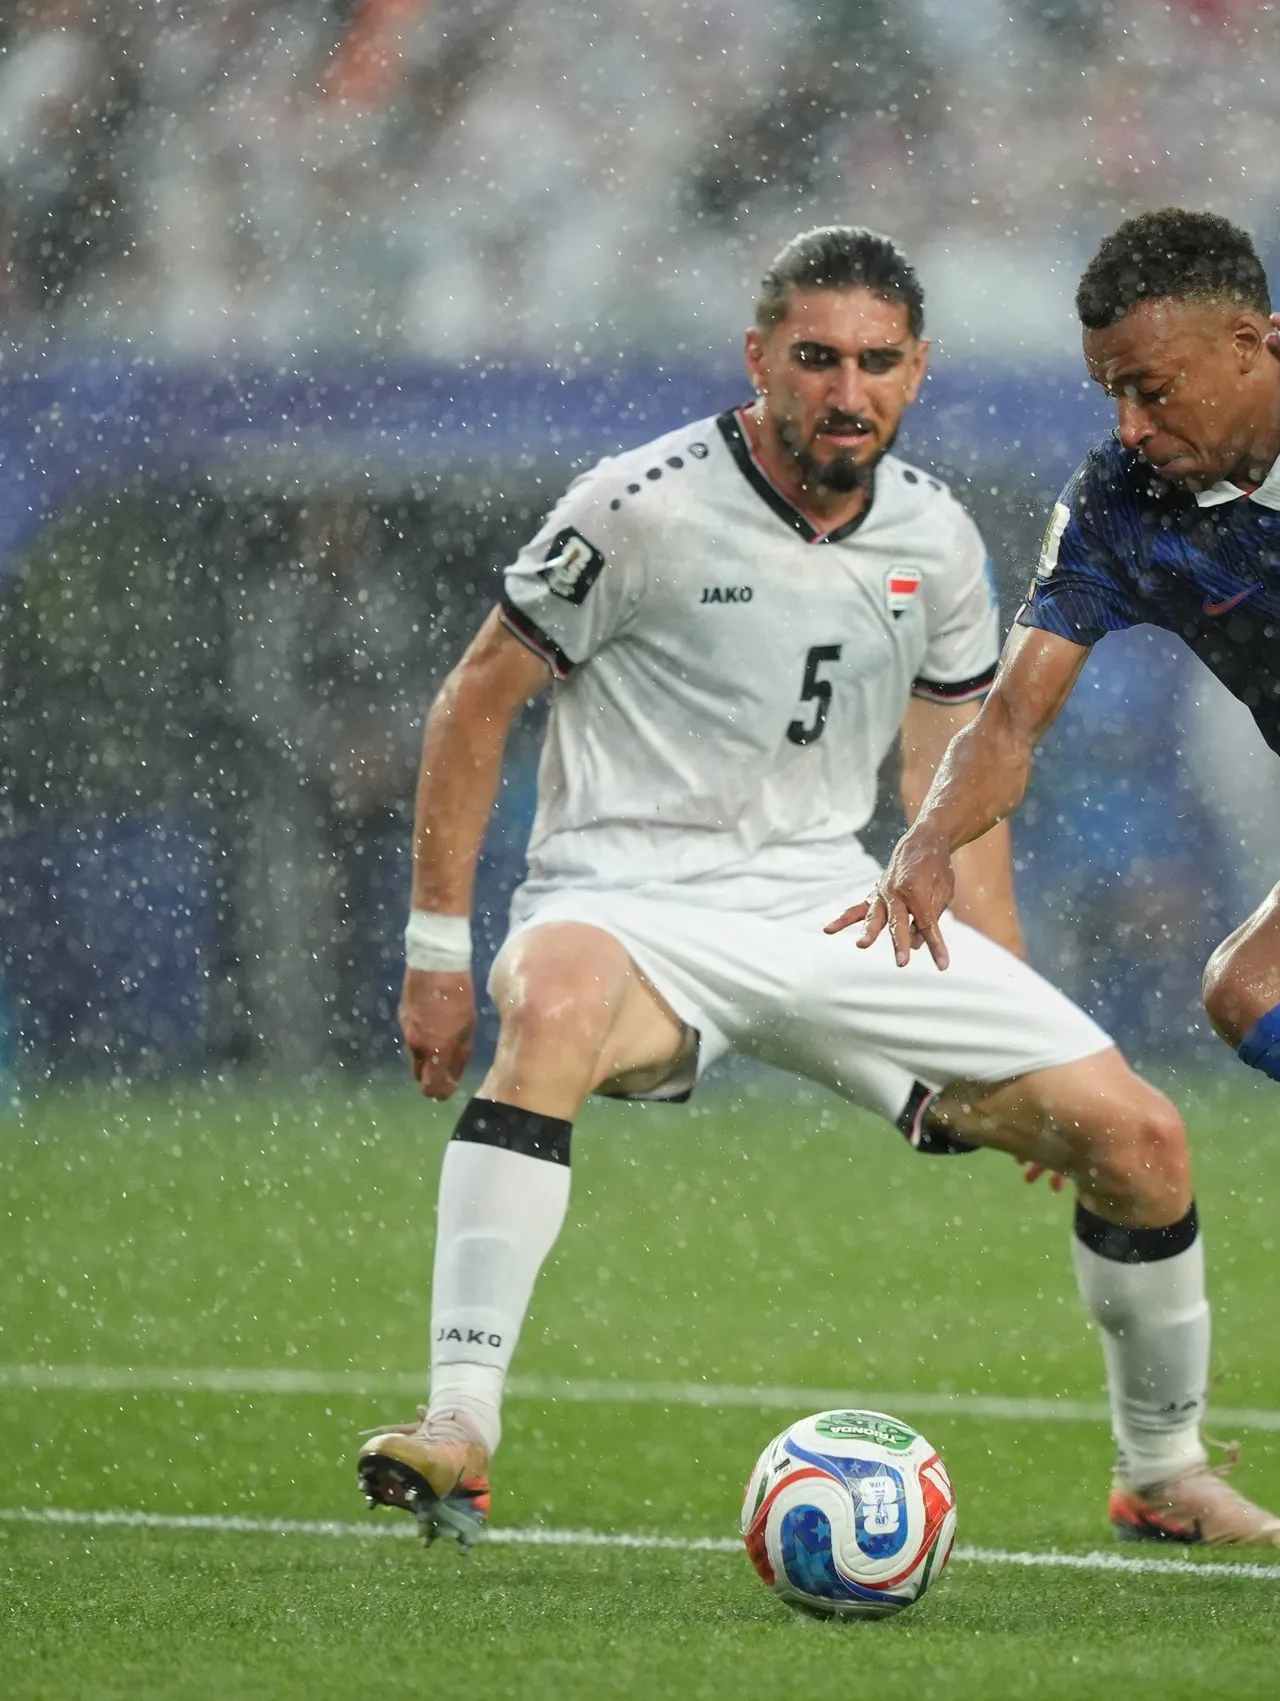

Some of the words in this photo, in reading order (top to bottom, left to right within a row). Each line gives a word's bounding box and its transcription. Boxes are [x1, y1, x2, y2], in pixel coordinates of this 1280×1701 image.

[700, 586, 754, 605] JAKO
[786, 644, 842, 746] 5
[436, 1327, 502, 1348] JAKO
[830, 1426, 897, 1444] TRIONDA
